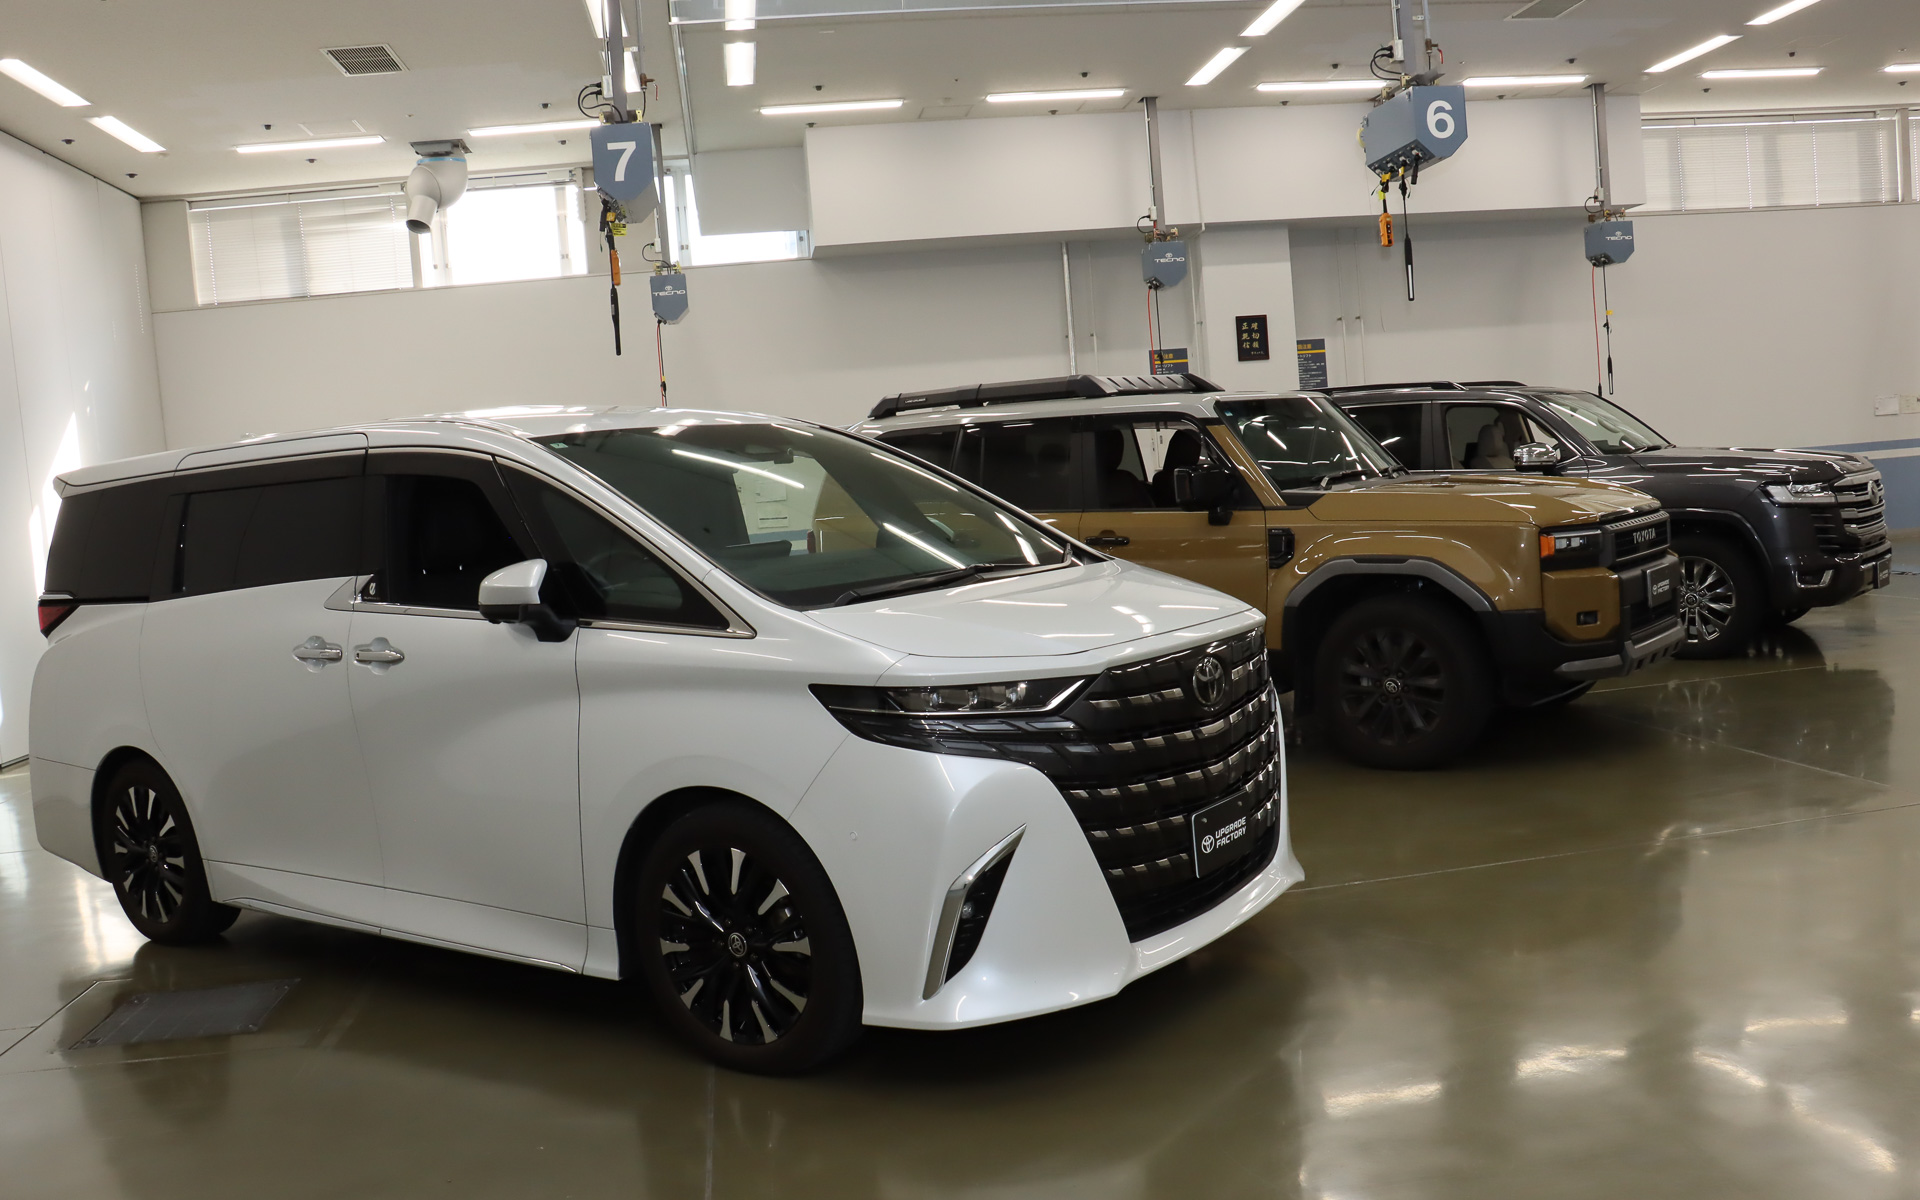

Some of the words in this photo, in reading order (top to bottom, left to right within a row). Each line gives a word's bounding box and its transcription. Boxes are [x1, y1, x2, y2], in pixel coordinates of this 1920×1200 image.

[1426, 100, 1455, 139] 6
[606, 141, 637, 182] 7
[1633, 528, 1656, 544] TOYOTA
[1215, 816, 1246, 838] UPGRADE
[1216, 826, 1246, 848] FACTORY
